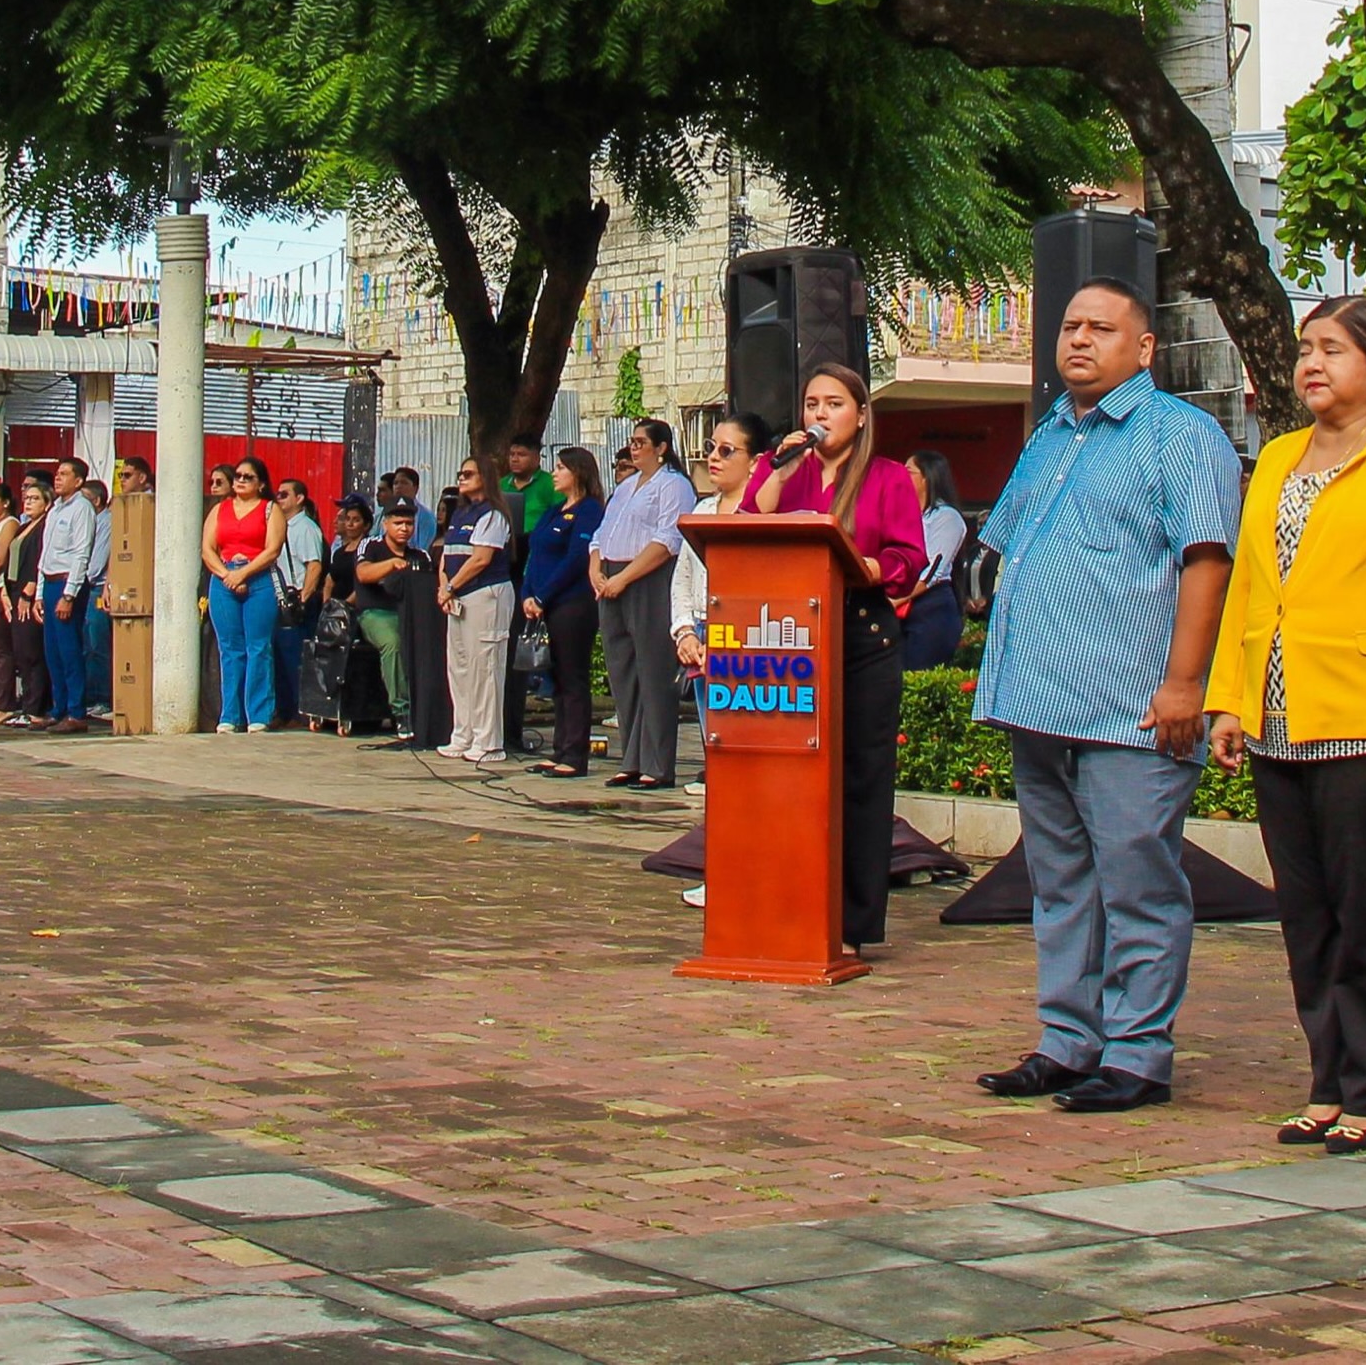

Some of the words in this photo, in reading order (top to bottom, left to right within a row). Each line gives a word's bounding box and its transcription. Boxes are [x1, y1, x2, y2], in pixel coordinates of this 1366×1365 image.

[708, 624, 741, 648] EL
[709, 655, 814, 679] NUEVO
[708, 683, 814, 712] DAULE
